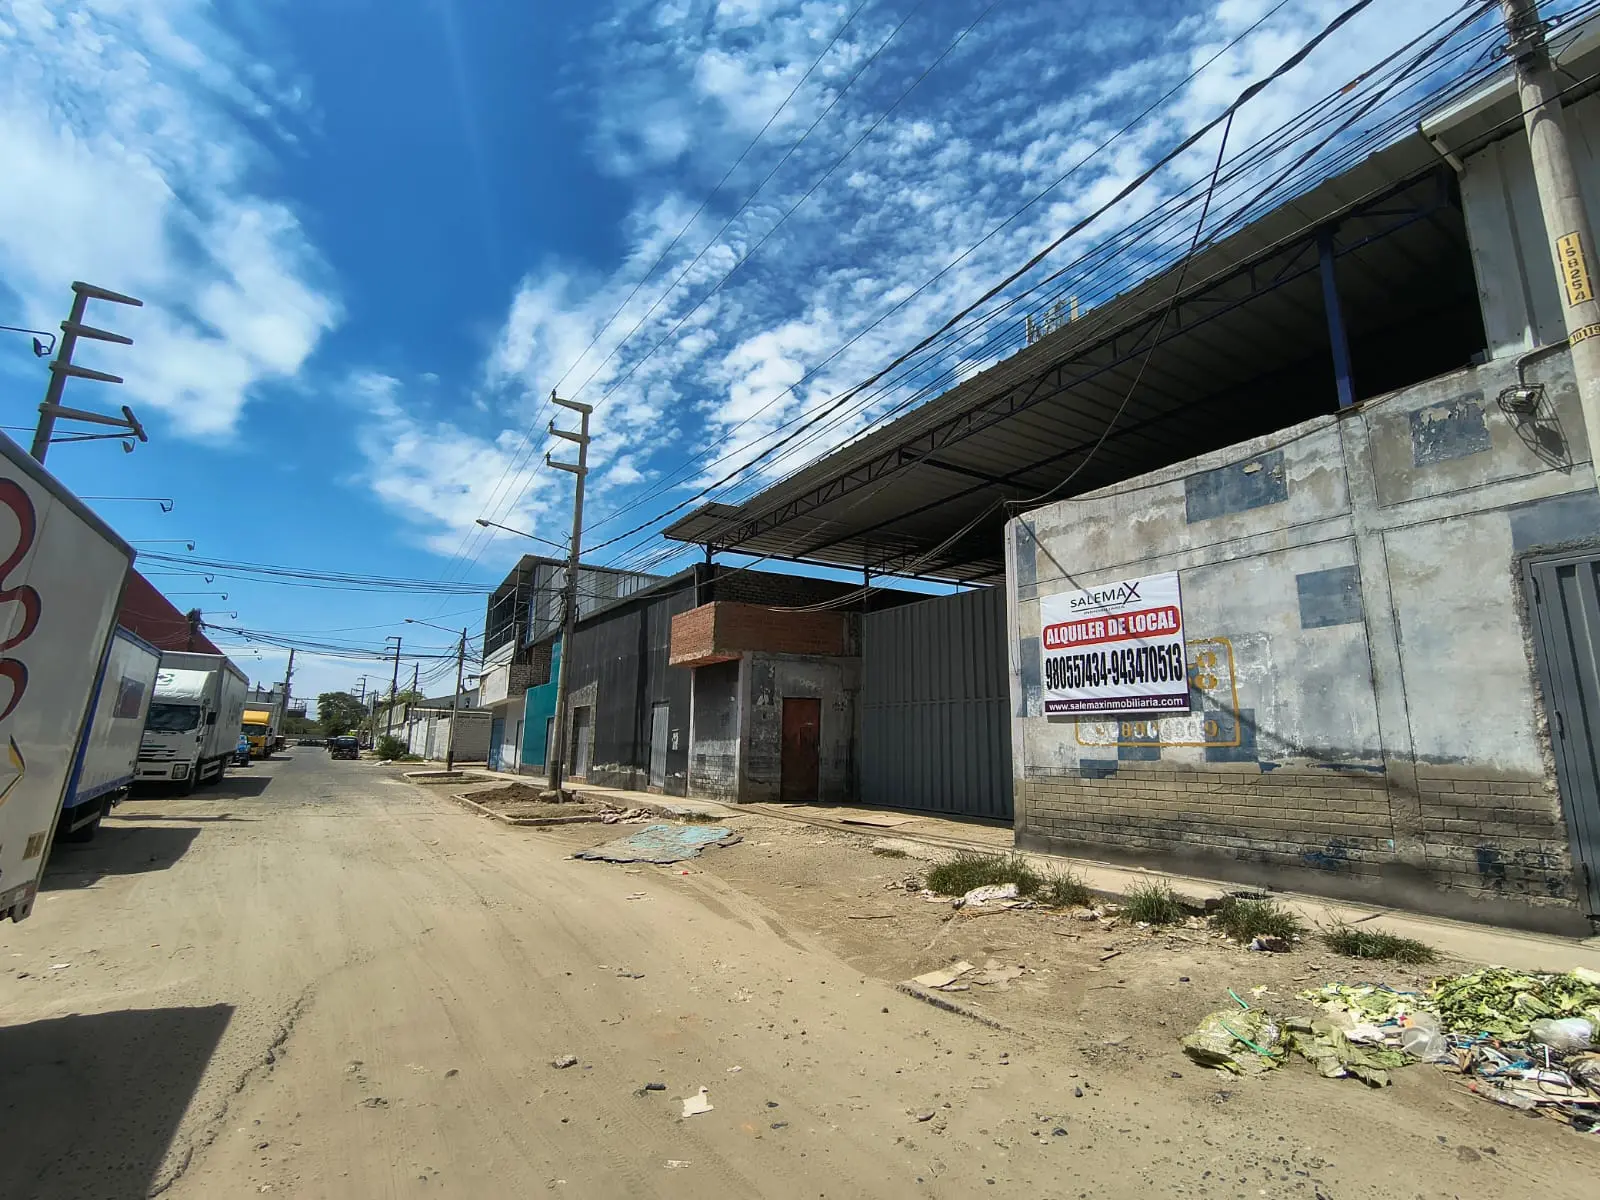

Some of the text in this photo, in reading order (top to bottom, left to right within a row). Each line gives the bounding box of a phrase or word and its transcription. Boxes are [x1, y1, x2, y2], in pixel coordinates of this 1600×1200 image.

[1563, 237, 1587, 301] 158254
[1070, 581, 1141, 608] SALEMAX
[1046, 621, 1105, 645] ALQUILER
[1108, 617, 1126, 636] DE
[1128, 610, 1177, 633] LOCAL
[1045, 643, 1183, 690] 980557434-943470513
[1048, 697, 1184, 711] www.salemaxinmobiliaria.com
